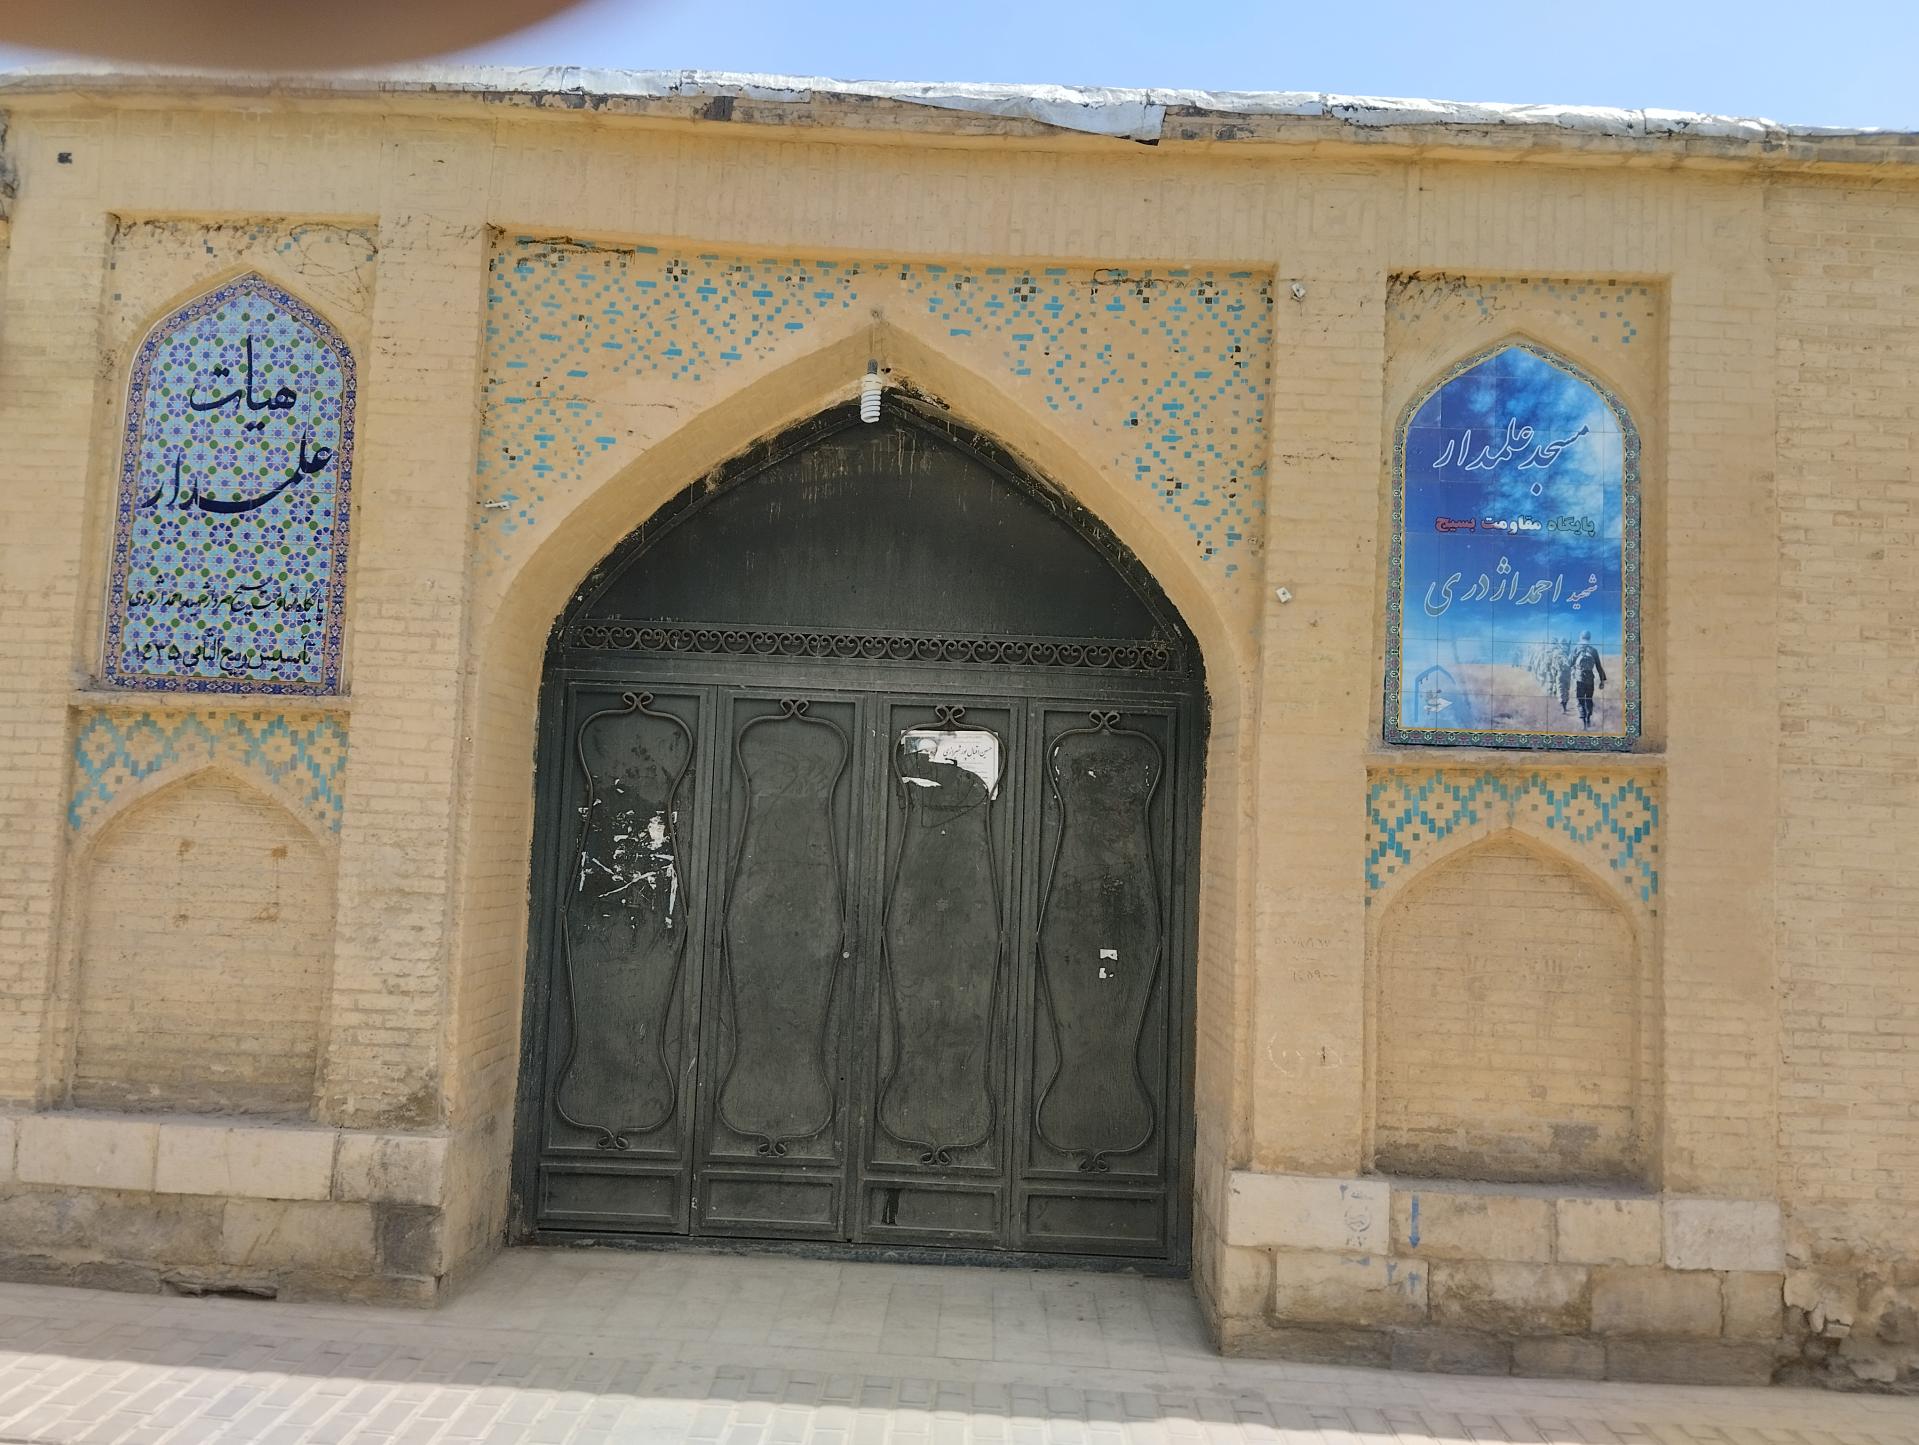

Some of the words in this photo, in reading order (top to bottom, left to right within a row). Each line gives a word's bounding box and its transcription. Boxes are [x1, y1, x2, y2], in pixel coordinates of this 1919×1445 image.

[1432, 417, 1535, 470] علمدار
[1517, 425, 1590, 496] مسجد
[141, 428, 333, 514] علمدار
[1435, 515, 1477, 533] بسیج
[1481, 514, 1542, 535] مقاومت
[1547, 515, 1597, 537] پایگاه
[128, 574, 166, 607] اژدری
[231, 573, 272, 616] بسیج
[252, 583, 297, 611] مقاومت
[1423, 555, 1521, 617] اژدری
[1515, 573, 1564, 605] احمد
[1566, 573, 1598, 610] شهید
[297, 588, 325, 626] پایگاه
[220, 648, 248, 677] ربیع
